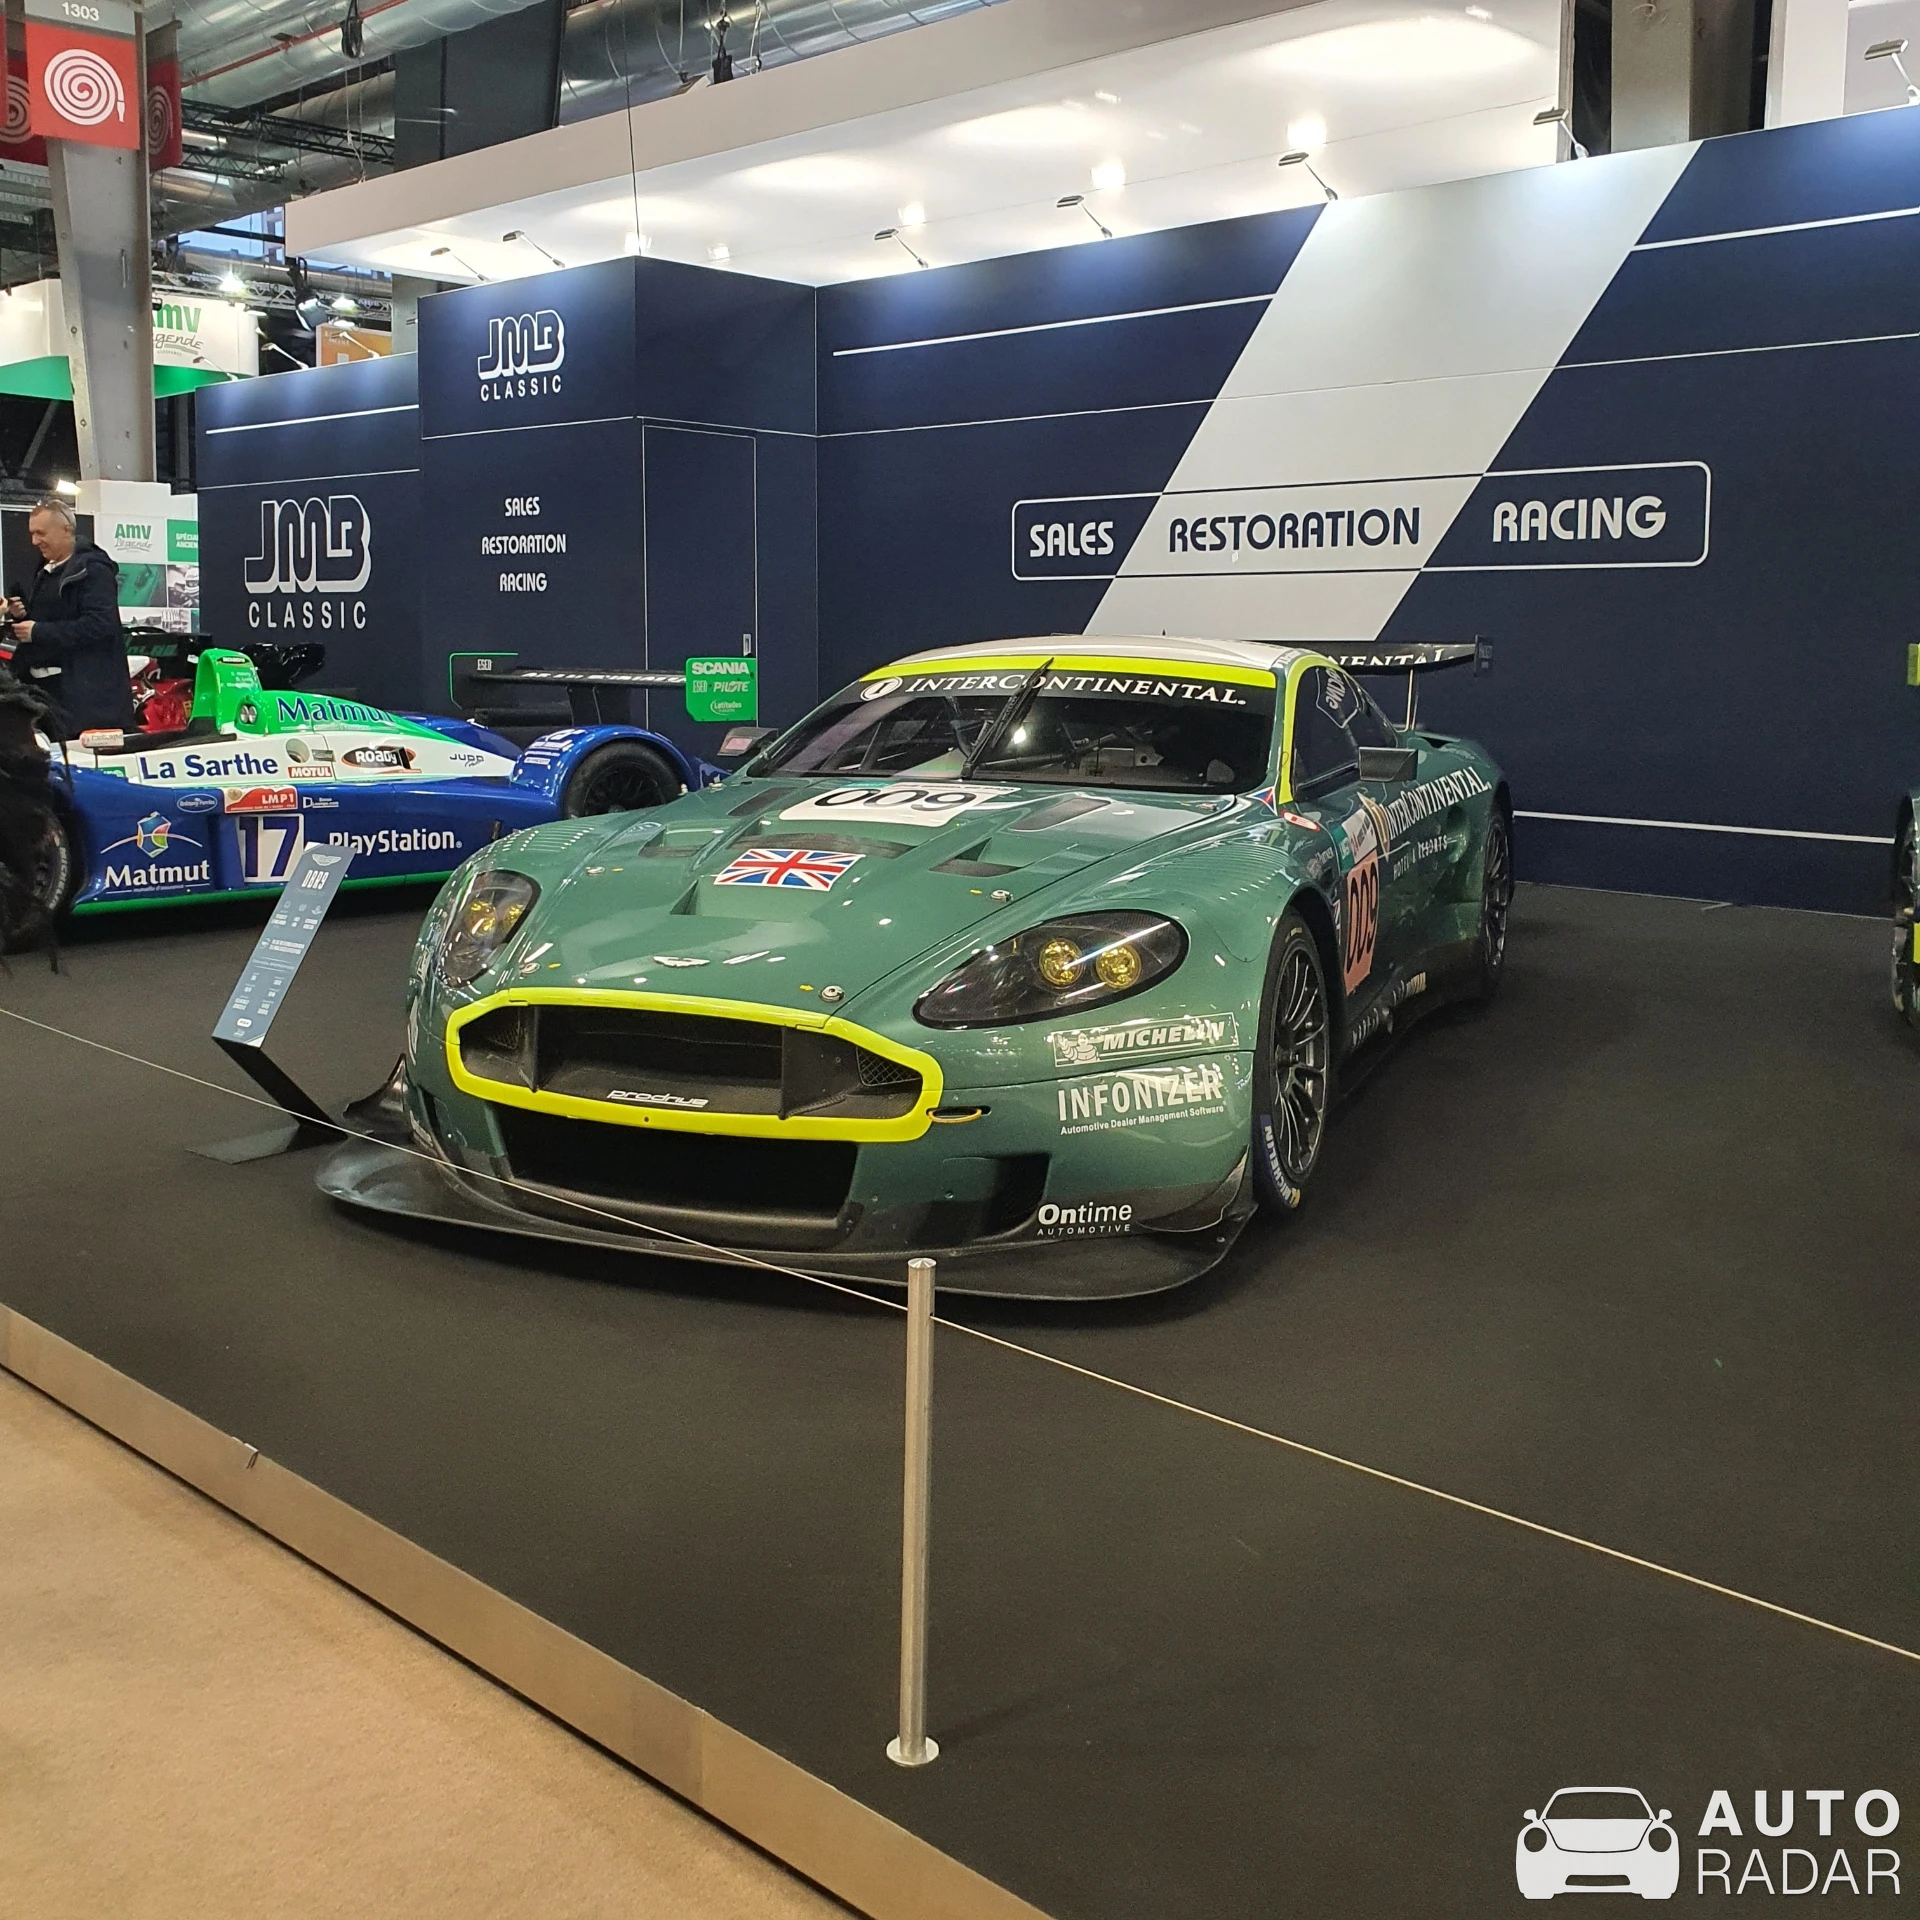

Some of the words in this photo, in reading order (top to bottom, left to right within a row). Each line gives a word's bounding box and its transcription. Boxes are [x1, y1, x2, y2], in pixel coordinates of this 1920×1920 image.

[62, 2, 99, 21] 1303
[155, 334, 204, 350] gende
[478, 309, 565, 380] JMB
[480, 375, 562, 401] CLASSIC
[504, 496, 540, 517] SALES
[1029, 520, 1114, 558] SALES
[1169, 507, 1420, 553] RESTORATION
[1492, 495, 1667, 543] RACING
[244, 494, 372, 594] JMB
[481, 533, 567, 555] RESTORATION
[499, 572, 548, 592] RACING
[248, 600, 367, 630] CLASSIC
[691, 661, 750, 675] SCANIA
[139, 757, 176, 779] La
[184, 752, 279, 778] Sarthe
[449, 753, 485, 762] JUDD
[291, 766, 331, 778] MOTUL
[814, 788, 977, 812] 009
[239, 815, 301, 878] 17
[105, 859, 210, 888] Matmut
[1346, 861, 1378, 974] 009
[1102, 1021, 1225, 1051] MICHELIN
[607, 1090, 708, 1106] prodrive
[1058, 1070, 1223, 1121] INFONIZER
[1060, 1121, 1110, 1135] Automotive
[1110, 1117, 1137, 1128] Dealer
[1138, 1110, 1189, 1125] Management
[1189, 1105, 1224, 1116] Software
[1264, 1125, 1292, 1200] MICHELIN
[1038, 1202, 1132, 1225] Ontime
[1037, 1224, 1131, 1236] AUTOMOTIVE
